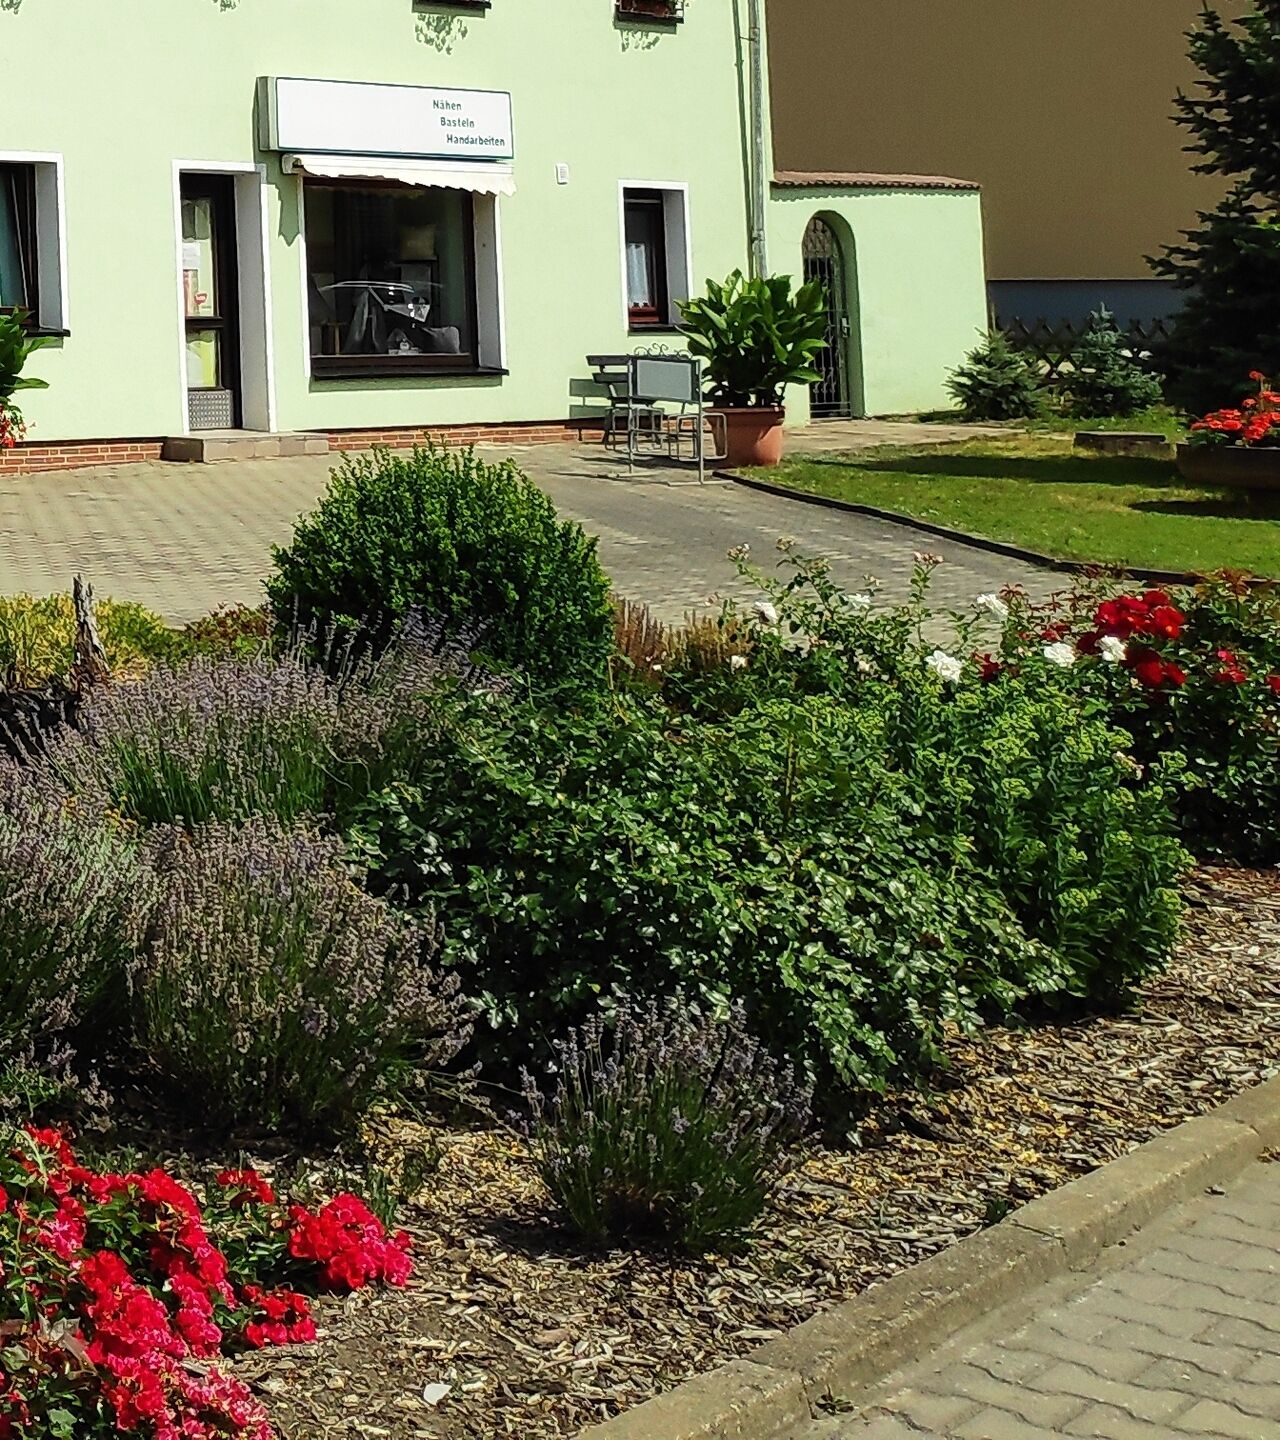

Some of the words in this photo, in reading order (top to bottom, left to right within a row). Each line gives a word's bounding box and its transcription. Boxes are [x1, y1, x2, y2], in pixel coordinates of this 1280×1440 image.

[432, 99, 462, 111] Nähen
[440, 116, 475, 128] Basteln
[446, 133, 505, 146] Handarbeiten
